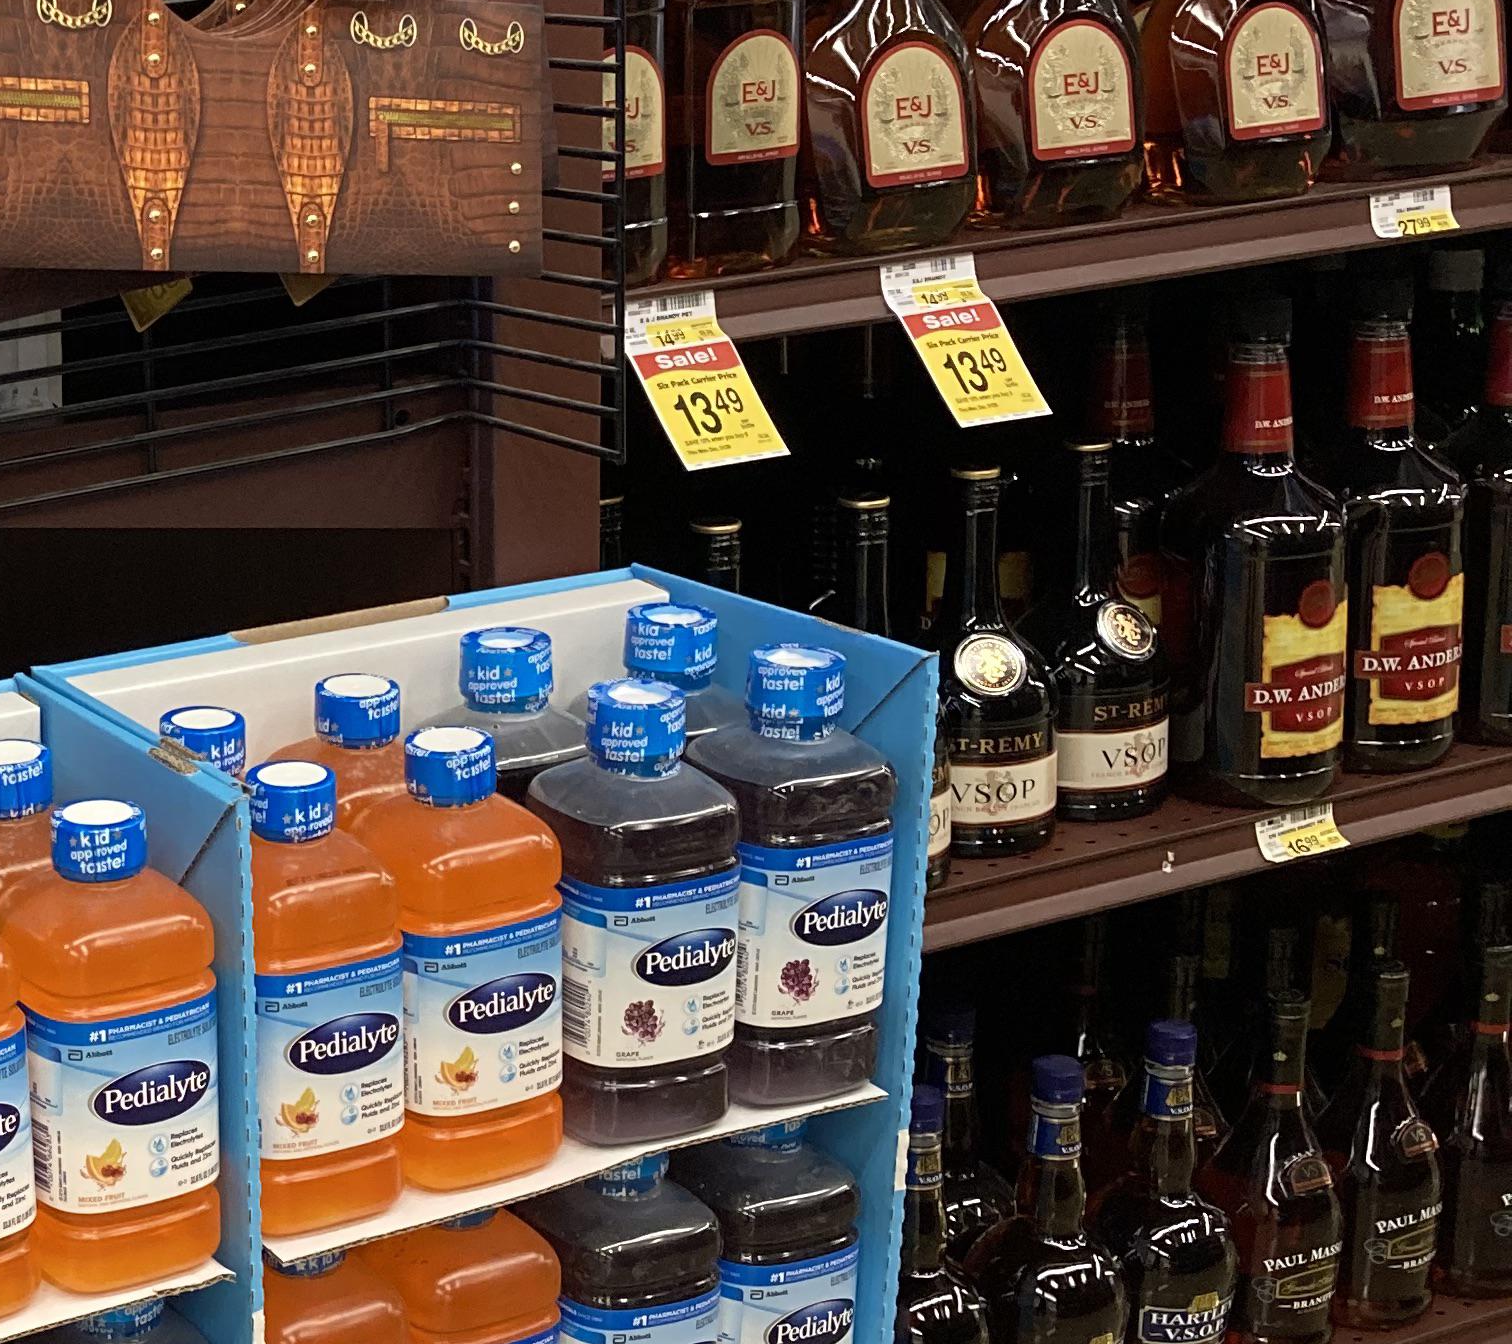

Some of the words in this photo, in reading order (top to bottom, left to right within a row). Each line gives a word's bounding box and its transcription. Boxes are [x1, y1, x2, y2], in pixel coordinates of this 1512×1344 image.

[1432, 8, 1471, 37] E&J
[1438, 58, 1472, 75] V.S.
[742, 78, 777, 105] E&J
[896, 94, 933, 120] E&J
[745, 120, 776, 136] V.S.
[902, 138, 936, 155] V.S.
[922, 308, 981, 328] Sale!
[654, 348, 719, 370] Sale!
[670, 379, 689, 389] Pack
[691, 375, 720, 386] Carrier
[721, 372, 738, 383] Price
[1362, 655, 1402, 673] D.W.
[761, 677, 805, 692] taste!
[1405, 677, 1446, 693] VSOP
[951, 777, 1037, 807] VSOP
[803, 899, 887, 935] Pedialyte
[457, 981, 555, 1023] Pedialyte
[299, 1021, 398, 1063] Pedialyte
[104, 1068, 208, 1114] Pedialyte
[1375, 1214, 1418, 1234] PAUL
[1263, 1253, 1308, 1273] PAUL
